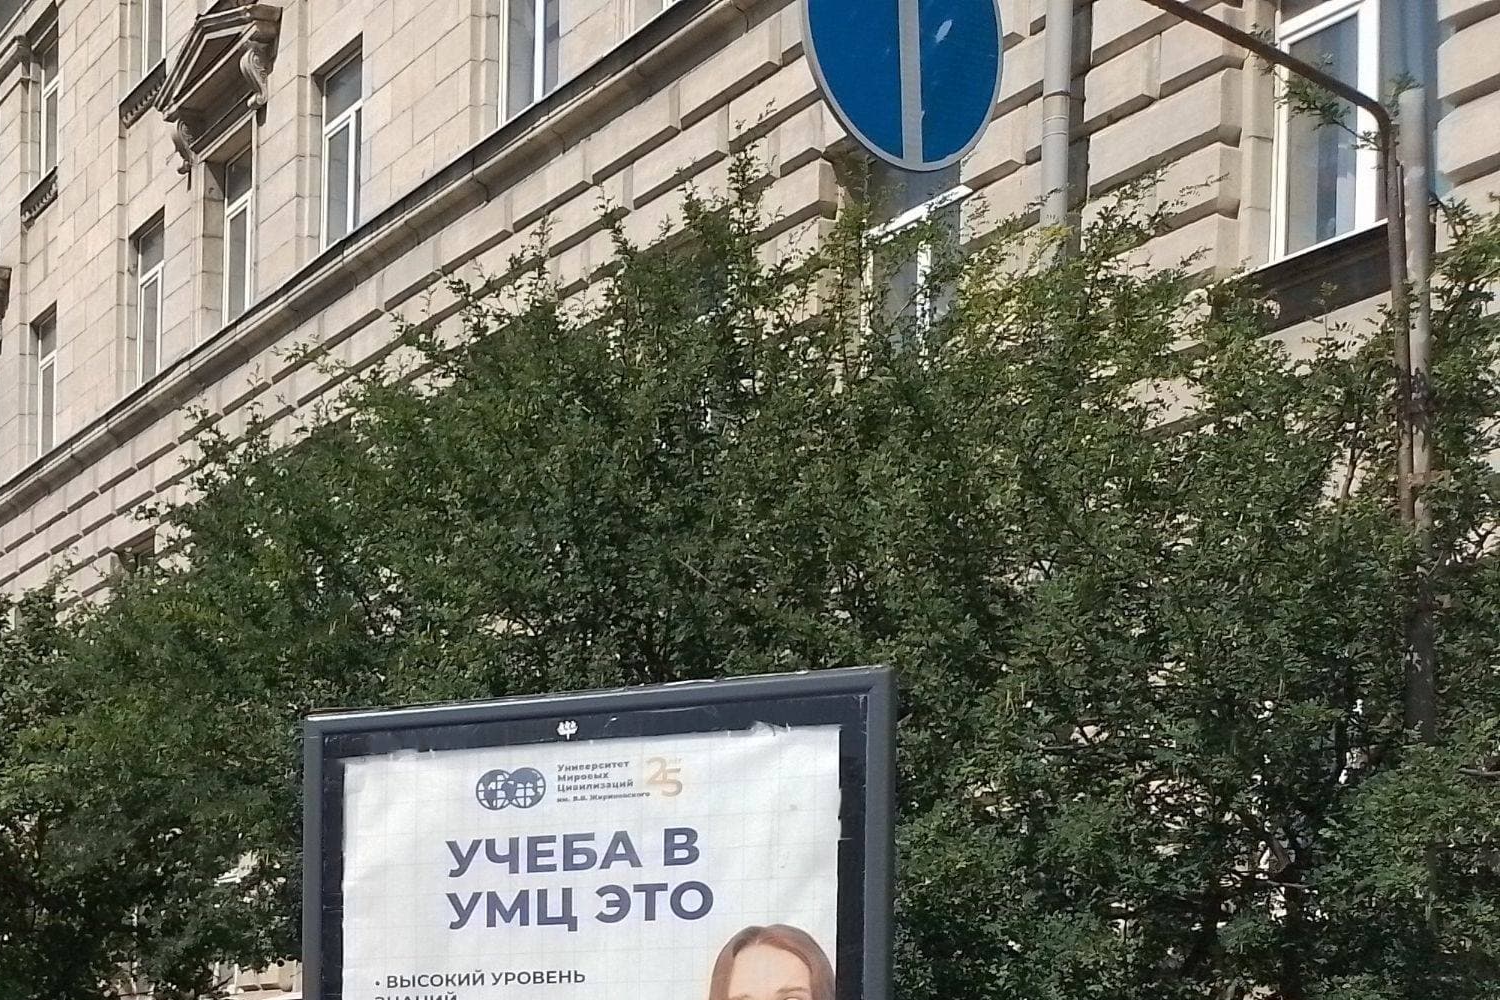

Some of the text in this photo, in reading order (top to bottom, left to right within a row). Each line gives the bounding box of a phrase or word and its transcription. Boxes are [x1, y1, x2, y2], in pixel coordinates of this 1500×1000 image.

[557, 761, 630, 772] Университет
[557, 772, 609, 783] Мировых
[557, 779, 634, 793] Цивилизаций
[445, 827, 701, 878] УЧЕБА В
[445, 880, 714, 932] УМЦ ЭТО
[386, 969, 586, 989] ВЫСОКИЙ УРОВЕНЬ
